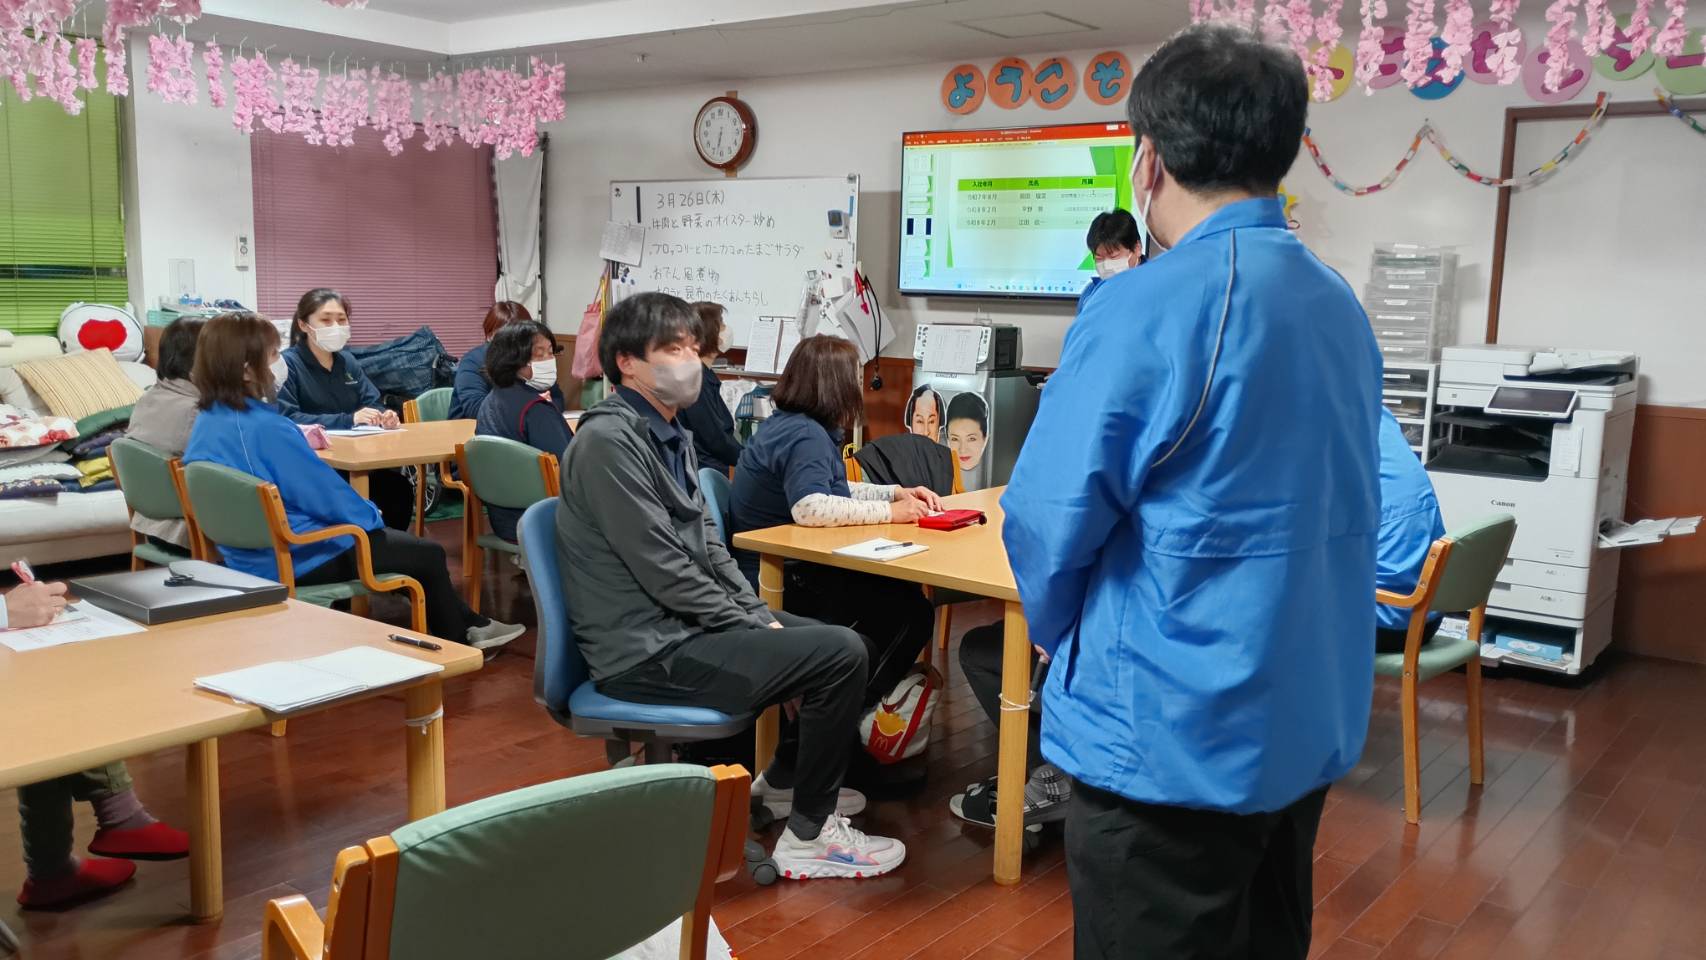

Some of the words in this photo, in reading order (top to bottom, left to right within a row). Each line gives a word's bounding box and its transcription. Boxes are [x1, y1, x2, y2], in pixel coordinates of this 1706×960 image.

[949, 58, 1124, 109] ようこそ
[1490, 499, 1516, 508] Canon
